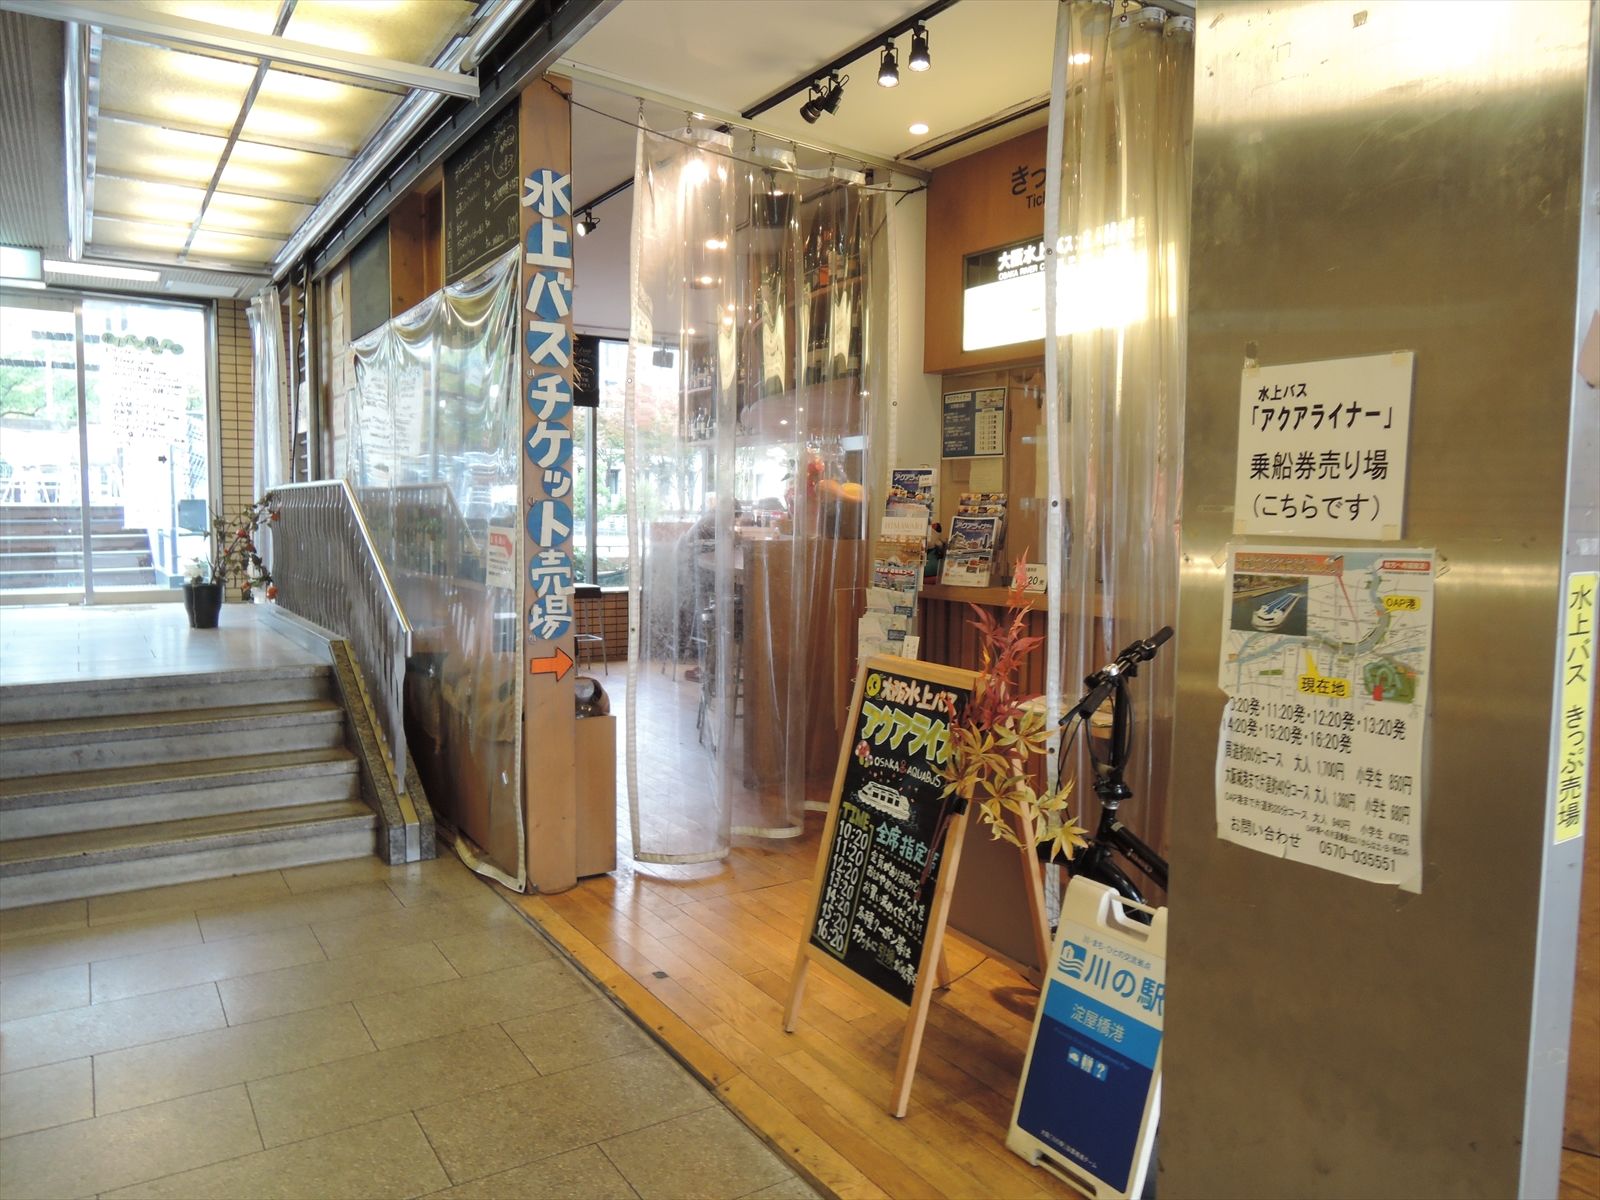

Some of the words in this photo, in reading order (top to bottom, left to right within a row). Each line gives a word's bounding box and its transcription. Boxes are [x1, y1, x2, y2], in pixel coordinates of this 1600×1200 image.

[521, 169, 575, 640] 水上バスチケット売場
[1258, 383, 1308, 402] 水上バス
[1251, 401, 1393, 432] 「アクアライナー」
[1250, 450, 1389, 480] 乗船券売り場
[1566, 585, 1592, 686] 水上バス
[881, 677, 958, 717] 大阪水上バス
[1301, 677, 1346, 697] 現在地
[874, 756, 900, 772] OSAKA
[906, 768, 942, 788] AQUABUS
[1557, 705, 1586, 829] きっぷ売場
[841, 801, 872, 830] TIME
[839, 819, 868, 850] 10:20
[835, 836, 863, 867] 11:20
[832, 853, 859, 885] 12:20
[829, 870, 855, 900] 13:20
[825, 886, 851, 917] 14:20
[822, 902, 848, 935] 15:20
[817, 918, 844, 952] 16:20
[1070, 1003, 1125, 1043] 淀屋橋港
